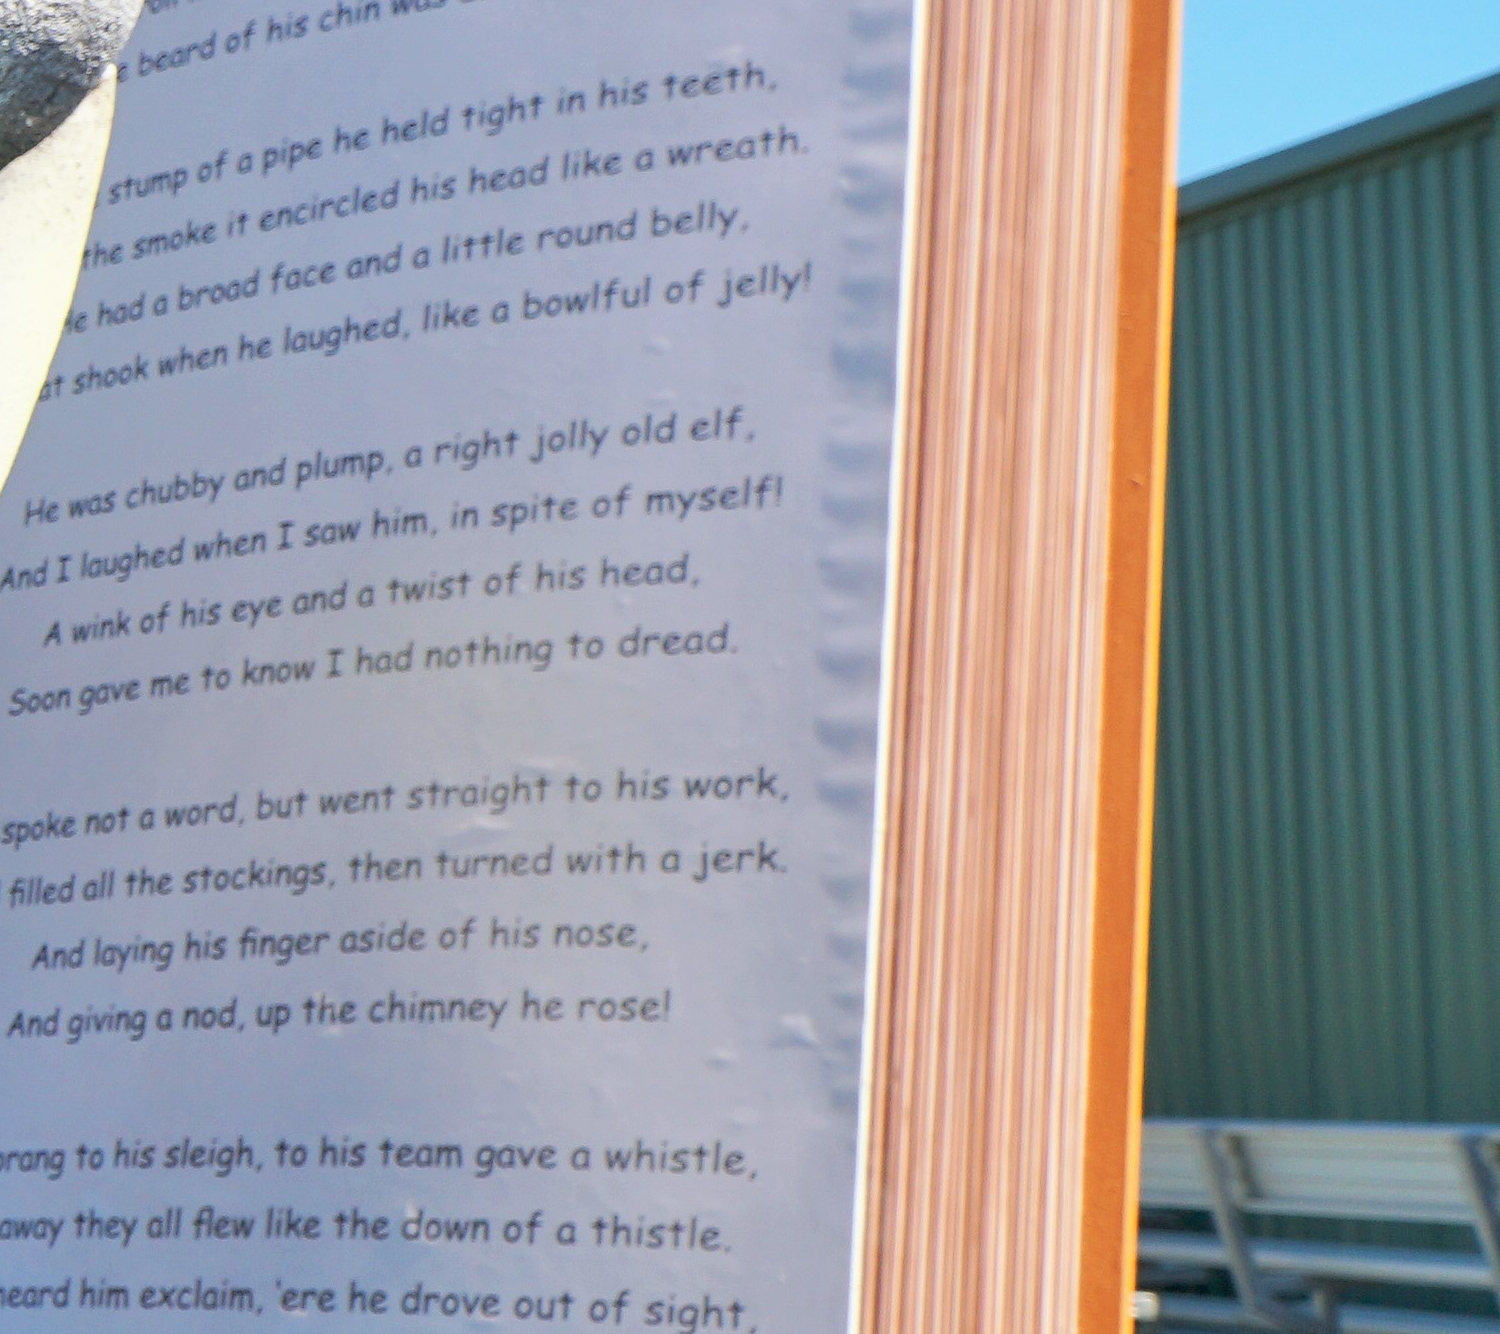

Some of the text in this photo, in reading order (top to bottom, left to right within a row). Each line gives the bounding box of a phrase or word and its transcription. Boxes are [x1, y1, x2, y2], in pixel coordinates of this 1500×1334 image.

[23, 497, 60, 528] He
[68, 490, 117, 519] was
[124, 470, 226, 510] chubby
[233, 456, 287, 492] and
[403, 445, 423, 469] a
[433, 429, 520, 471] right
[529, 418, 610, 465] jolly
[620, 411, 678, 447] old
[42, 620, 62, 648] A
[71, 609, 131, 644] wink
[139, 601, 171, 635] of
[179, 598, 222, 628] his
[230, 595, 283, 629] eye
[291, 579, 349, 616] and
[356, 585, 375, 608] a
[386, 571, 472, 604] twist
[483, 561, 522, 596] of
[534, 560, 587, 592] his
[8, 687, 72, 717] Soon
[78, 679, 141, 716] gave
[149, 673, 190, 698] me
[200, 665, 232, 692] to
[241, 657, 316, 686] know
[326, 647, 345, 679] I
[355, 641, 415, 675] had
[424, 634, 554, 672] nothing
[566, 632, 605, 660] to
[0, 810, 76, 851] spoke
[84, 806, 131, 835] not
[137, 808, 156, 831] a
[255, 789, 309, 821] but
[318, 784, 396, 816] went
[406, 771, 552, 815] straight
[563, 774, 603, 803] to
[615, 768, 671, 801] his
[8, 873, 77, 909] filled
[81, 869, 115, 902] all
[124, 866, 173, 898] the
[347, 851, 423, 883] then
[435, 843, 554, 878] turned
[565, 840, 647, 875] with
[659, 849, 682, 874] a
[30, 938, 86, 971] And
[93, 934, 175, 974] laying
[183, 930, 228, 961] his
[237, 925, 331, 966] finger
[338, 920, 427, 954] aside
[438, 916, 477, 950] of
[489, 916, 541, 949] his
[6, 1006, 61, 1038] And
[66, 1004, 148, 1045] giving
[155, 1008, 174, 1032] a
[255, 1003, 292, 1036] up
[301, 995, 357, 1025] the
[367, 990, 509, 1030] chimney
[520, 988, 564, 1021] he
[75, 1143, 105, 1171] to
[113, 1138, 157, 1170] his
[274, 1138, 309, 1168] to
[319, 1134, 367, 1168] his
[378, 1138, 464, 1169] team
[474, 1144, 557, 1179] gave
[569, 1146, 591, 1171] a
[79, 1276, 130, 1310] him
[347, 1279, 388, 1314] he
[400, 1282, 500, 1317] drove
[513, 1290, 575, 1321] out
[587, 1288, 631, 1326] of
